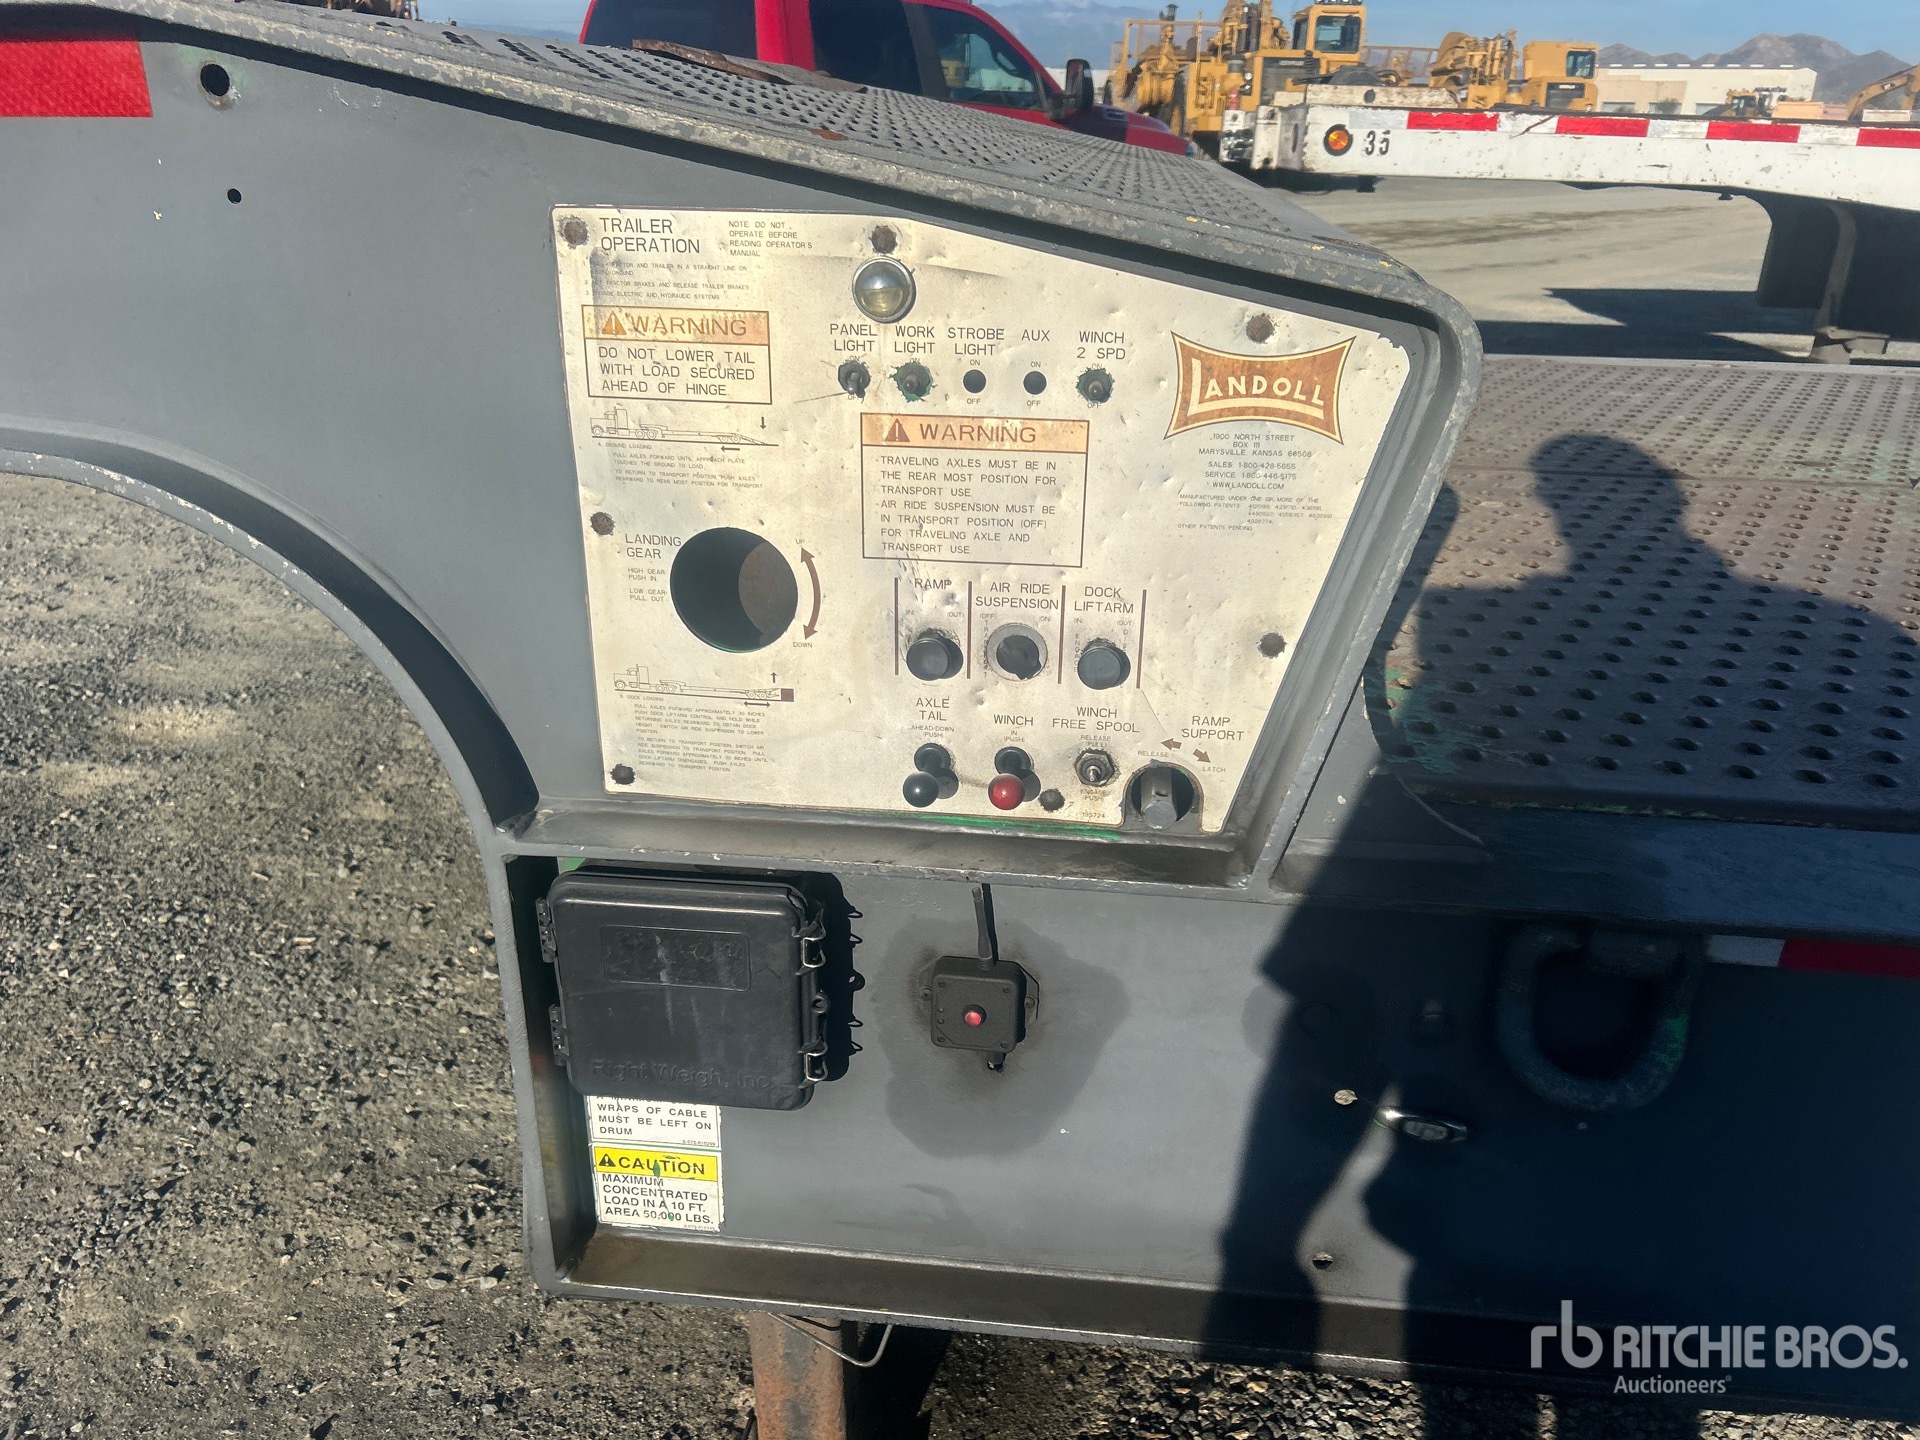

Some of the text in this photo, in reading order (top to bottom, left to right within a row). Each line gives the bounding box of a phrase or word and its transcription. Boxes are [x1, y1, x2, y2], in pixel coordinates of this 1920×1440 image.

[1365, 130, 1391, 156] 35
[600, 217, 673, 234] TRAILER
[729, 230, 764, 238] OPERATE
[600, 237, 700, 254] OPERATION
[630, 316, 747, 336] WARNING
[830, 324, 1125, 344] PANEL WORK STROBE AUX WINCH
[598, 346, 755, 364] DO NOT LOWER TAIL
[833, 340, 1126, 360] LIGHT LIGHT LIGHT 2 SPD
[600, 364, 755, 380] WITH LOAD SECURED
[602, 381, 648, 393] AHEAD
[658, 382, 676, 394] OF
[1187, 357, 1324, 420] LANDOLL
[920, 424, 1037, 444] WARNING
[946, 458, 982, 468] AXLES
[988, 459, 1018, 469] MUST
[1025, 460, 1039, 470] BE
[1046, 461, 1056, 470] IN
[881, 471, 1057, 485] THE REAR MOST POSITION FOR
[881, 485, 971, 497] TRANSPORT USE
[904, 501, 927, 510] RIDE
[934, 502, 999, 513] SUSPENSION
[1006, 504, 1035, 514] MUST
[1042, 506, 1056, 515] BE
[881, 514, 1047, 529] IN TRANSPORT POSITION (OFF)
[625, 533, 682, 546] LANDING
[881, 528, 1030, 543] FOR TRAVELING AXLE AND
[626, 547, 661, 559] GEAR
[882, 543, 943, 554] TRANSPORT
[914, 578, 1122, 599] RAMP AIR RIDE DOCK
[976, 596, 1134, 613] SUSPENSION LIFTARM
[916, 697, 950, 709] AXLE
[920, 710, 947, 721] TAIL
[1077, 706, 1118, 718] WINCH
[994, 714, 1034, 726] WINCH
[1052, 718, 1140, 733] FREE SPOOL
[1192, 716, 1231, 727] RAMP
[1182, 728, 1245, 741] SUPPORT
[590, 1059, 650, 1082] Right
[597, 1103, 708, 1118] WRAPS OF CABLE
[598, 1115, 629, 1124] MUST
[660, 1119, 688, 1128] LEFT
[696, 1122, 712, 1130] ON
[600, 1126, 632, 1135] DRUM
[618, 1156, 705, 1175] CAUTION
[602, 1174, 664, 1186] MAXIMUM
[603, 1184, 708, 1201] CONCENTRATED
[604, 1196, 706, 1212] LOAD IN A 10 FT.
[605, 1207, 640, 1217] AREA
[686, 1214, 714, 1224] LBS.
